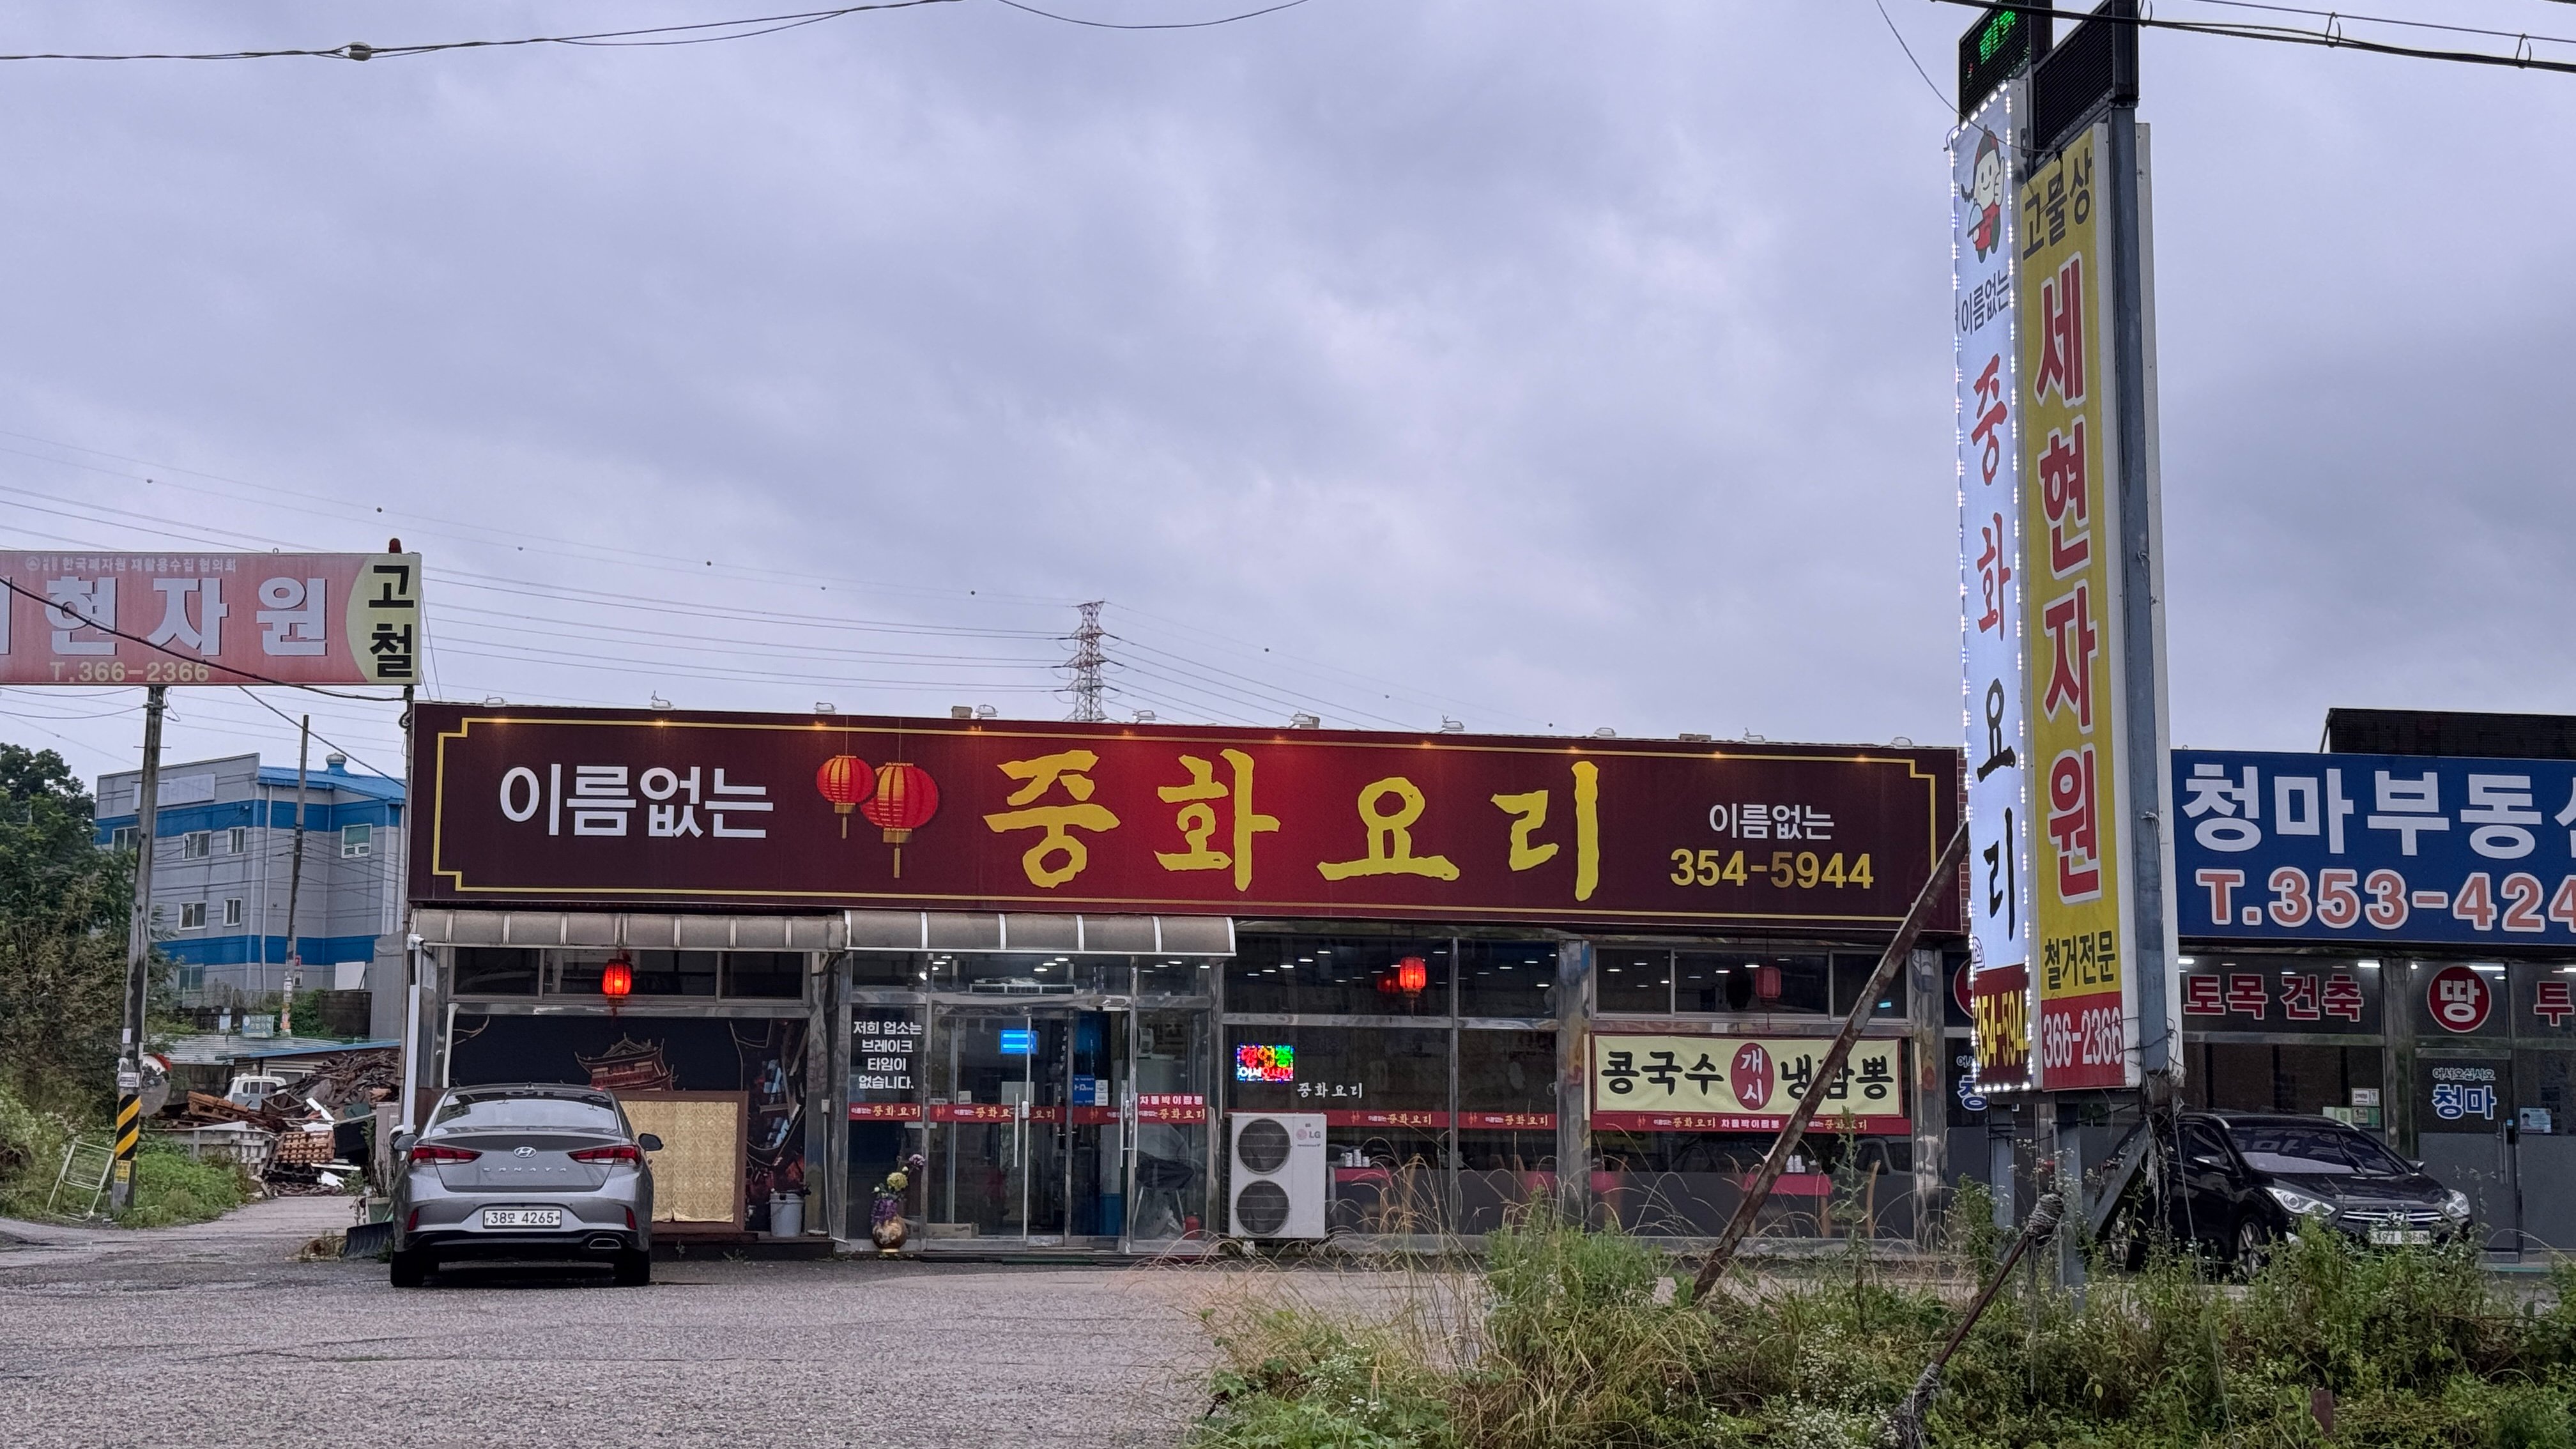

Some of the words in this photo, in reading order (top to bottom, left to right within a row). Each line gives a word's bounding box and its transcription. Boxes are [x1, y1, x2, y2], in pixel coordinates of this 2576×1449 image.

[2023, 147, 2092, 261] 고물상
[1961, 270, 2009, 335] 이름없는
[2036, 252, 2101, 903] 세현자원
[0, 576, 327, 656] 현자원
[369, 565, 415, 678] 고철
[1971, 353, 2016, 942] 중화요리
[50, 661, 210, 682] T.366-2366
[500, 763, 774, 838] 이름없는
[983, 747, 1599, 901] 중화요리
[1709, 803, 1835, 840] 이름없는
[1669, 848, 1874, 889] 354-5944
[2044, 930, 2116, 990] 철거전문
[2184, 974, 2268, 1020] 토목
[2280, 974, 2364, 1022] 건축
[2439, 979, 2481, 1022] 땅
[2533, 981, 2575, 1027] 투
[853, 1021, 880, 1035] 저희
[884, 1021, 923, 1035] 업소는
[861, 1039, 914, 1053] 브레이크
[2043, 1006, 2122, 1069] 366-2366
[859, 1075, 915, 1089] 없습니다.
[867, 1057, 907, 1071] 타임이
[1601, 1051, 1724, 1096] 콩국수
[1740, 1048, 1764, 1106] 개시
[2432, 1068, 2496, 1081] 어서오십시오
[1297, 1082, 1363, 1099] 중화요리
[2432, 1084, 2497, 1120] 청마
[873, 1105, 921, 1117] 중화요리
[975, 1107, 1012, 1119] 중화요
[1158, 1108, 1206, 1120] 중화요리
[1387, 1113, 1432, 1125] 중화요리
[1505, 1114, 1549, 1126] 중화요리
[1672, 1117, 1716, 1129] 중화요리
[521, 1212, 555, 1224] 4265
